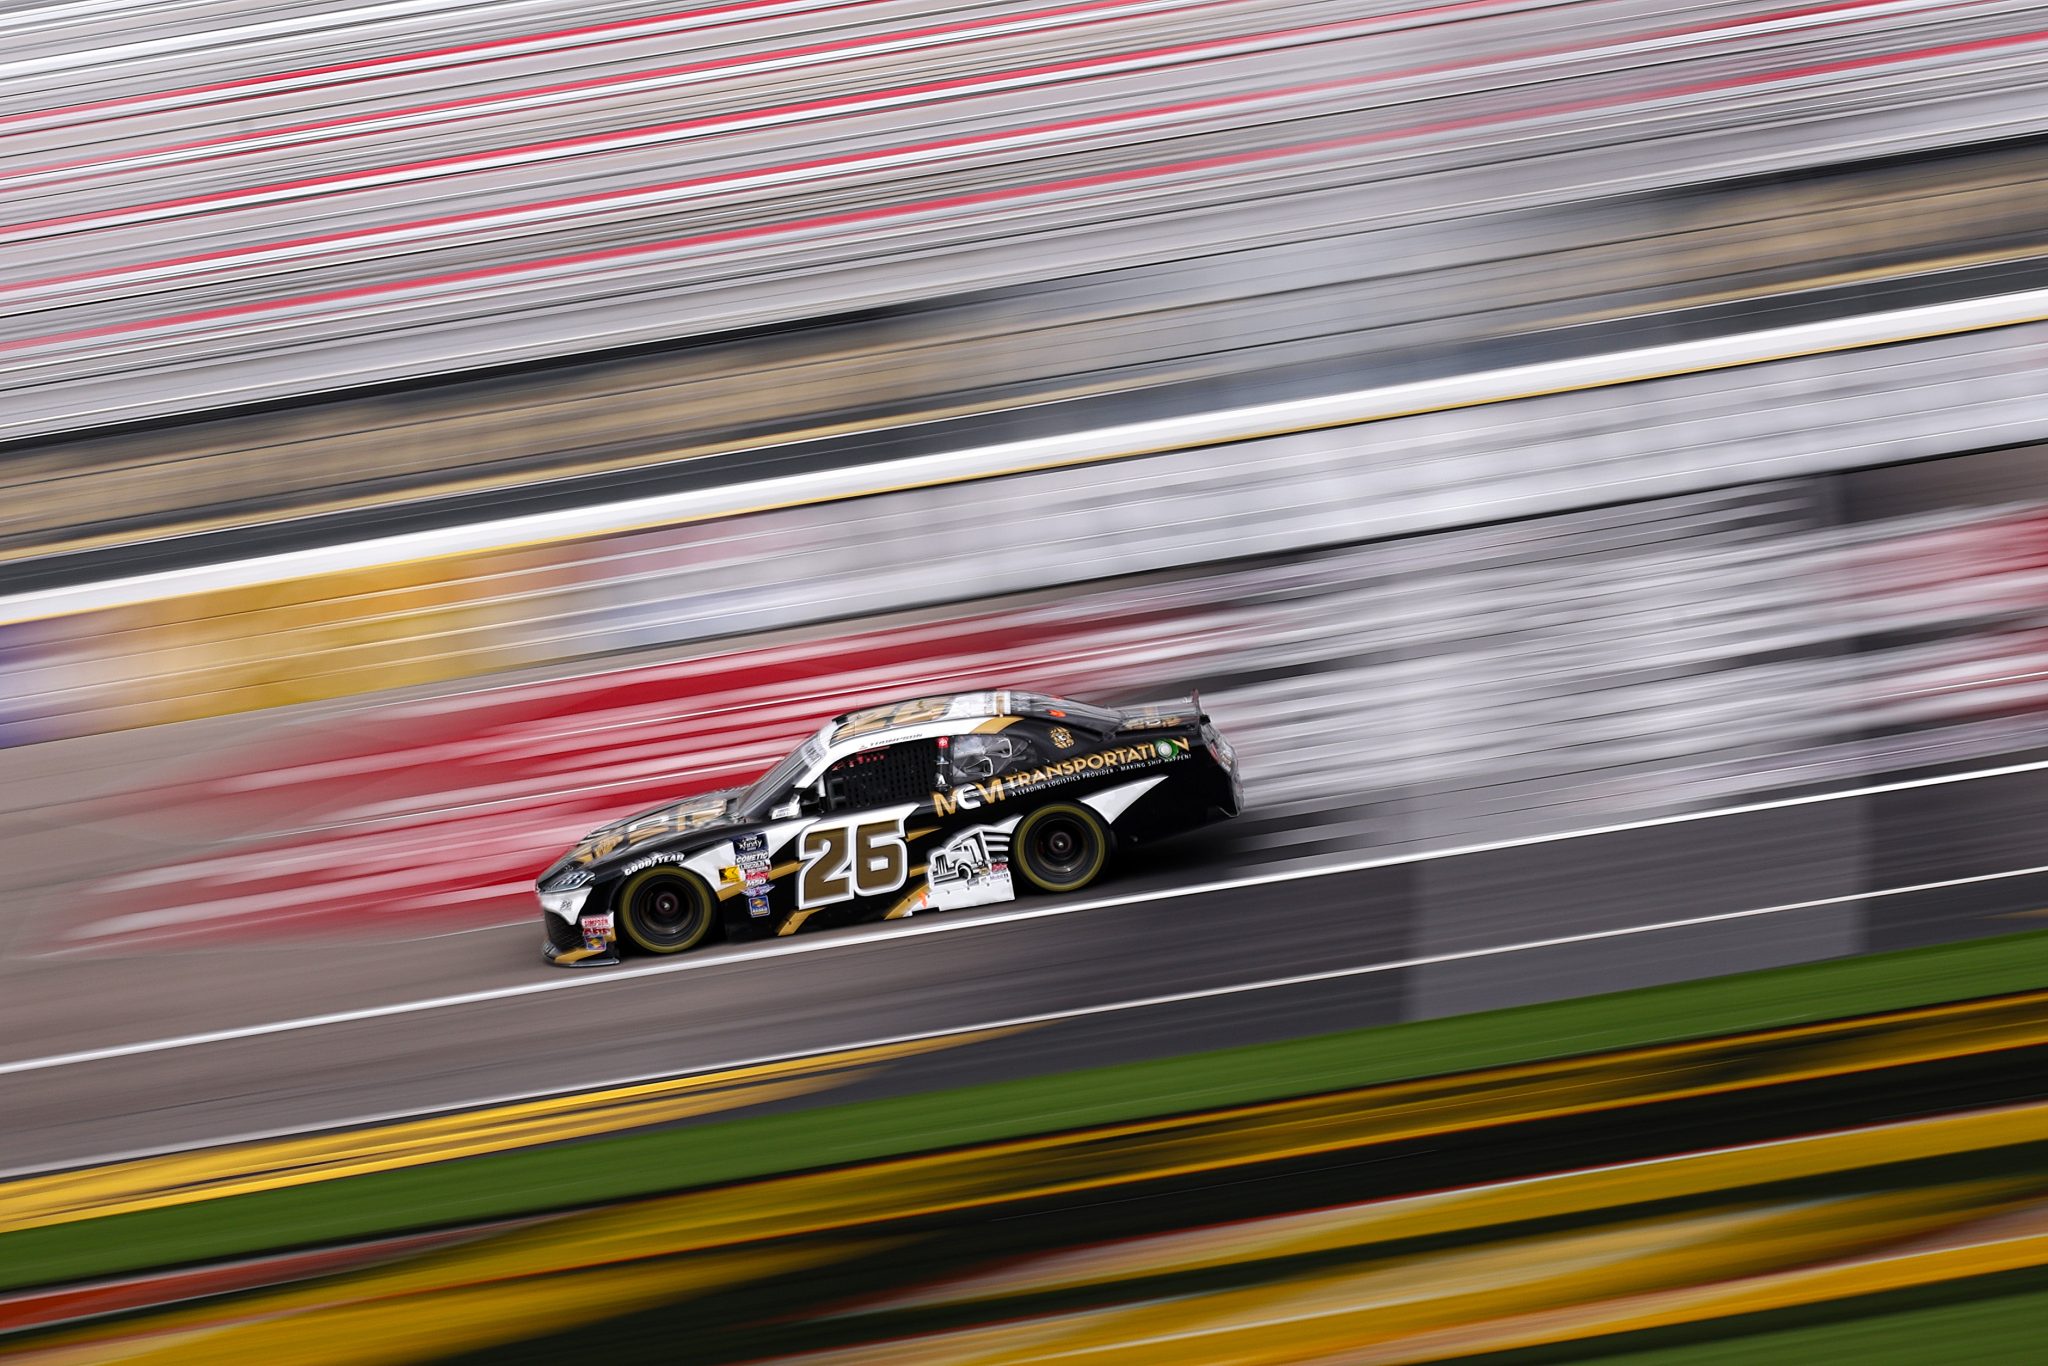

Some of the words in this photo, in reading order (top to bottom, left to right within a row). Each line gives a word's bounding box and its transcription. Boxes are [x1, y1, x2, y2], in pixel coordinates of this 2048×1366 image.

[1006, 736, 1190, 789] TRANSPORTATION
[1018, 783, 1046, 796] LEADING
[1048, 773, 1081, 788] LOGISTICS
[1082, 768, 1114, 779] PROVIDER
[1120, 761, 1146, 772] MAKING
[1148, 758, 1162, 767] SHIP
[1164, 753, 1192, 763] HAPPEN!
[624, 853, 685, 876] GOODYEAR
[736, 852, 768, 863] COMETIC
[802, 819, 904, 906] 26
